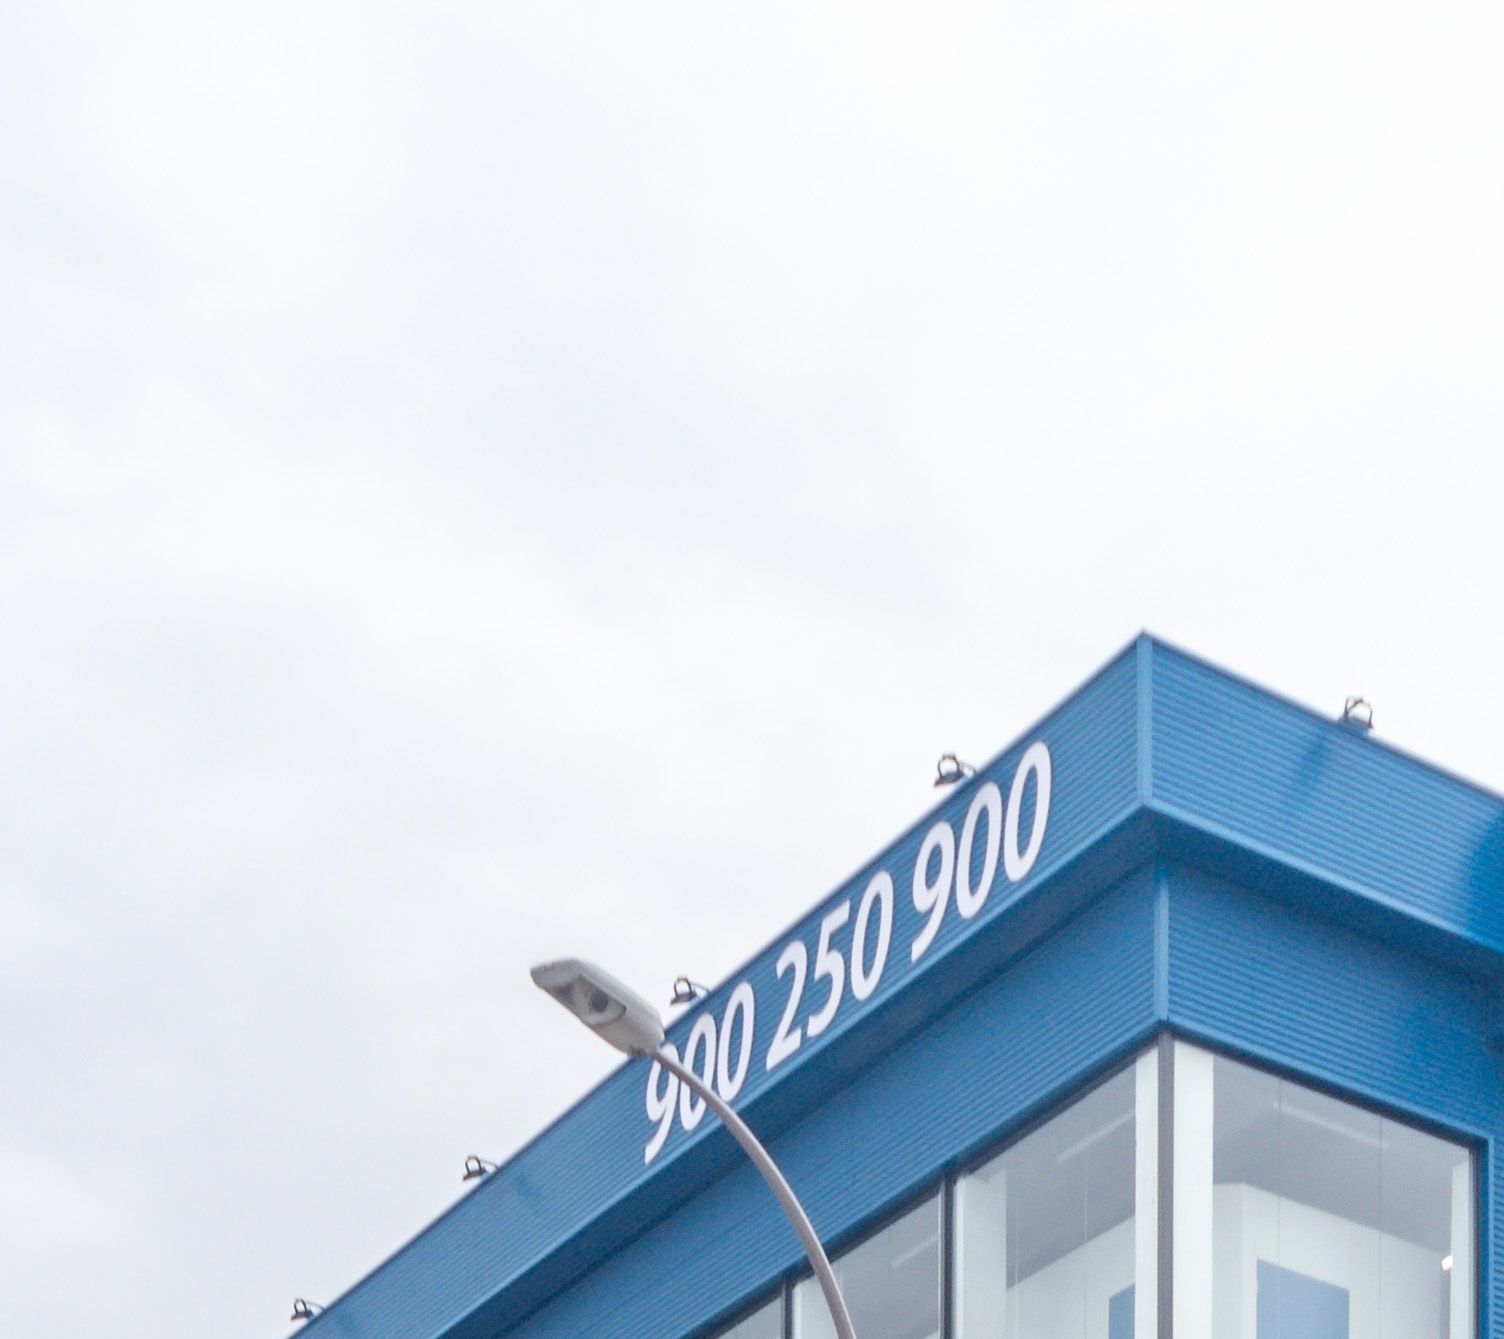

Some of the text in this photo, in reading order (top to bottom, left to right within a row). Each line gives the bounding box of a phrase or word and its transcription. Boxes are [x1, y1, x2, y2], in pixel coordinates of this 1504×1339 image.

[644, 740, 1052, 1166] 900 250 900
